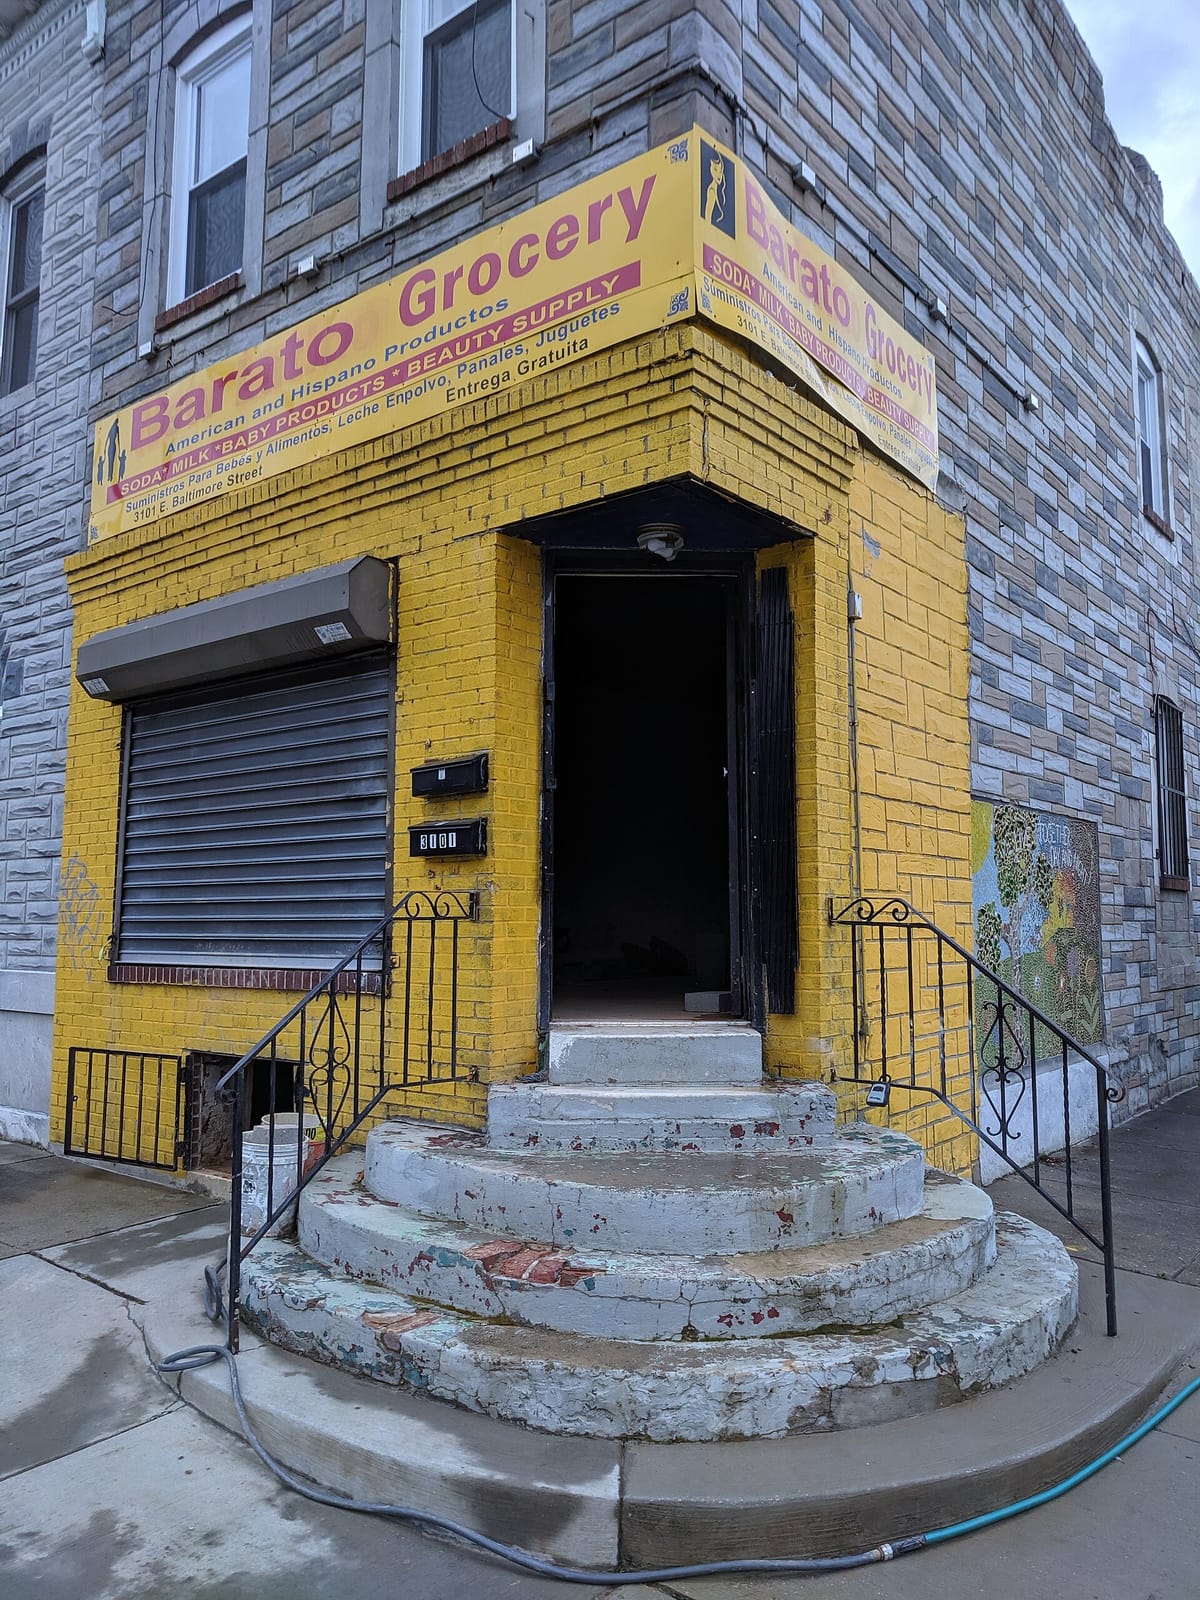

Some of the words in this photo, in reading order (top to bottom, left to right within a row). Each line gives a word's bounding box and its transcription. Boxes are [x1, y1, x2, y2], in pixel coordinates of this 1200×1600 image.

[130, 322, 354, 451] Barato
[399, 174, 657, 327] Grocery
[703, 275, 761, 324] Suministros
[737, 315, 758, 336] 3101
[744, 177, 851, 327] Barato
[864, 303, 932, 415] Grocery
[759, 285, 783, 323] MILK
[816, 339, 861, 393] PRODUCTS
[867, 386, 902, 423] BEAUTY
[904, 413, 931, 443] SUPPLY
[762, 261, 804, 315] American
[806, 310, 823, 332] and
[828, 324, 861, 364] Hispano
[862, 357, 903, 399] Productos
[126, 483, 186, 513] Suministros
[188, 469, 213, 487] Para
[255, 449, 263, 464] y
[265, 421, 333, 458] Alimentos,
[338, 402, 379, 428] Leche
[386, 373, 451, 408] Enpolvo,
[535, 302, 620, 348] Juguetes
[165, 414, 245, 457] American
[251, 395, 285, 420] and
[291, 358, 376, 402] Hispano
[384, 298, 509, 362] Productos
[172, 448, 210, 475] MILK
[275, 375, 385, 432] PRODUCTS
[407, 324, 504, 379] BEAUTY
[512, 274, 620, 334] SUPPLY
[446, 368, 511, 404] Entrega
[517, 337, 589, 376] Gratuita
[133, 505, 156, 523] 3101
[159, 503, 170, 516] E.
[172, 479, 223, 509] Baltimore
[226, 465, 264, 487] Street
[420, 832, 457, 850] 3101
